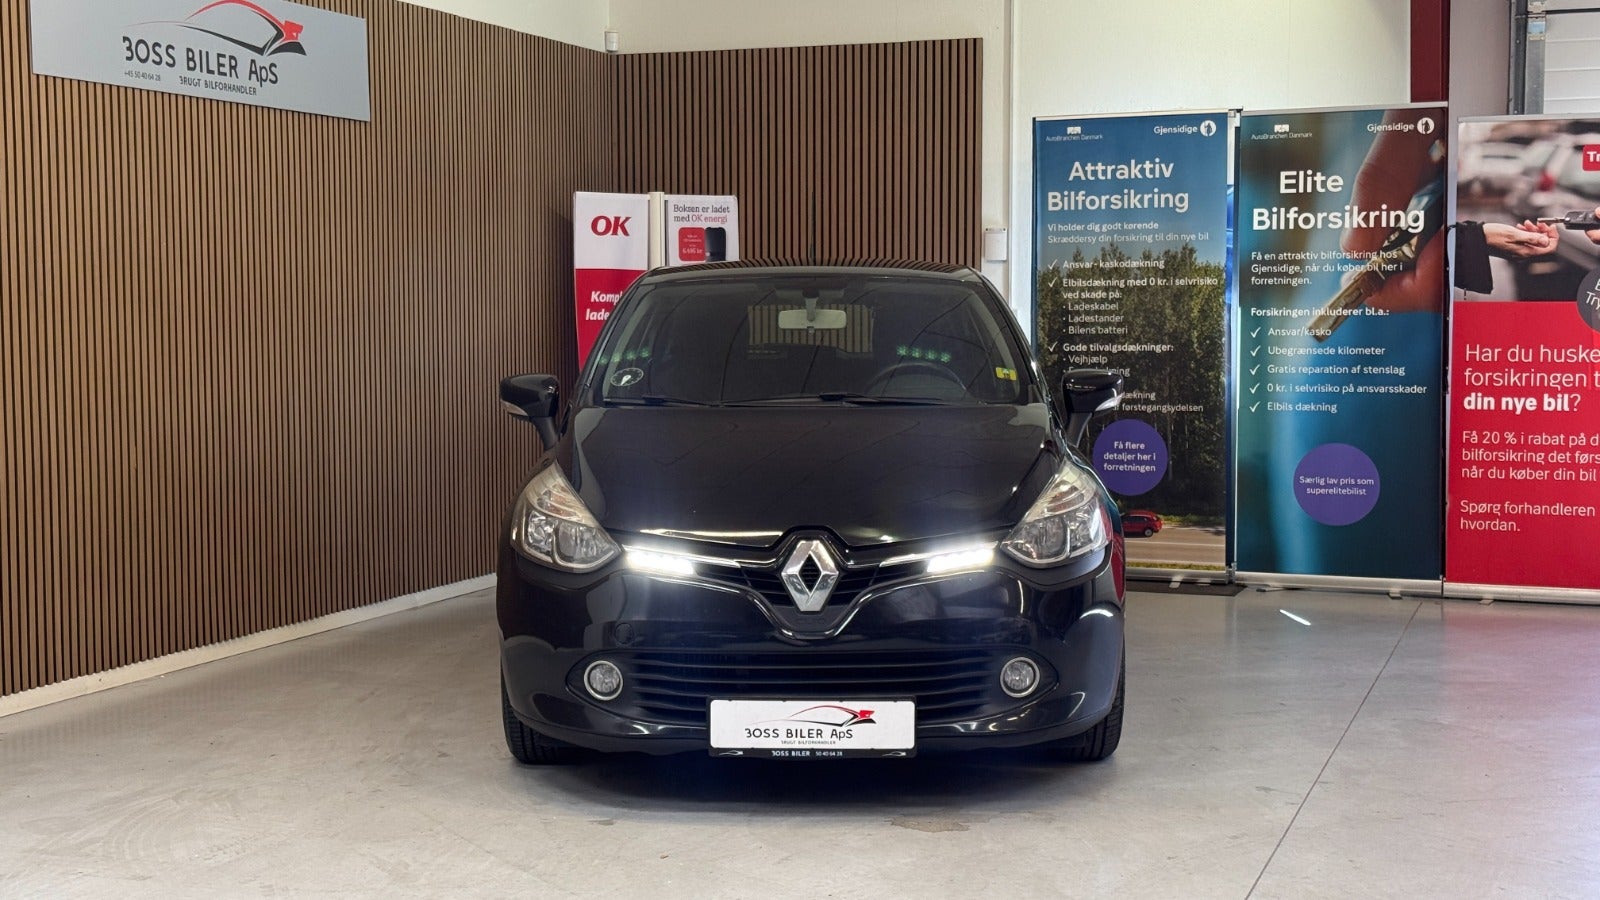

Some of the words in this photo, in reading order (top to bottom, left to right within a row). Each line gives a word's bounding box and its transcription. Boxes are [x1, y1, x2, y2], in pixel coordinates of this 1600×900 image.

[186, 47, 239, 79] BILER
[248, 58, 279, 87] ApS
[204, 79, 257, 96] BILFORHANDLER
[1153, 125, 1198, 136] Gjensidige
[1367, 122, 1415, 133] Gjensidige
[1068, 157, 1174, 181] Attraktiv
[1279, 169, 1344, 194] Elite
[1047, 187, 1190, 213] Bilforsikring
[673, 204, 700, 213] Boksen
[712, 204, 730, 214] ladet
[673, 214, 690, 222] med
[692, 214, 703, 222] OK
[704, 214, 728, 225] energi
[1252, 203, 1425, 234] Bilforsikring
[590, 215, 632, 237] OK
[1047, 223, 1057, 232] Vi
[1058, 222, 1085, 232] holder
[1086, 222, 1100, 232] dig
[1101, 222, 1122, 232] godt
[1123, 221, 1159, 230] kørende
[1047, 234, 1097, 245] Skræddersy
[1098, 234, 1112, 242] din
[1114, 233, 1153, 244] forsikring
[1155, 233, 1164, 241] til
[1165, 232, 1178, 241] din
[1180, 233, 1197, 243] nye
[1198, 232, 1209, 240] bil
[1251, 250, 1263, 261] Få
[1277, 250, 1319, 260] attraktiv
[1320, 250, 1377, 262] bilforsikring
[1379, 250, 1398, 260] hos
[1062, 260, 1098, 269] Ansvar-
[1099, 258, 1165, 270] kaskodækning
[1251, 263, 1303, 274] Gjensidige,
[1305, 262, 1321, 272] når
[1323, 263, 1335, 272] du
[1336, 262, 1364, 272] køber
[1367, 262, 1379, 272] bil
[1381, 262, 1398, 272] her
[1400, 262, 1403, 271] i
[1062, 278, 1126, 289] Elbilsdækning
[1127, 278, 1148, 286] med
[1149, 278, 1156, 286] 0
[1157, 278, 1169, 286] kr.
[1170, 278, 1174, 286] i
[1175, 276, 1218, 286] selvrisiko
[1251, 276, 1312, 287] forretningen.
[1062, 290, 1079, 299] ved
[1080, 290, 1107, 299] skade
[1108, 289, 1123, 300] på:
[1068, 302, 1119, 311] Ladeskabel
[1250, 307, 1310, 318] Forsikringen
[1312, 307, 1363, 316] inkluderer
[1365, 308, 1390, 316] bl.a.:
[1068, 314, 1124, 323] Ladestander
[1068, 326, 1096, 334] Bilens
[1097, 326, 1128, 334] batteri
[1267, 326, 1332, 337] Ansvar/kasko
[1062, 343, 1088, 352] Gode
[1090, 343, 1174, 353] tilvalgsdækninger:
[1267, 346, 1336, 357] Ubegrænsede
[1337, 346, 1386, 356] kilometer
[1465, 344, 1502, 362] Har
[1507, 344, 1533, 363] du
[1068, 355, 1108, 364] Vejhjælp
[1267, 364, 1296, 374] Gratis
[1298, 364, 1349, 376] reparation
[1351, 364, 1361, 374] af
[1363, 364, 1406, 376] stenslag
[1464, 368, 1587, 392] forsikringen
[1267, 383, 1274, 392] 0
[1276, 383, 1288, 392] kr.
[1294, 383, 1340, 393] selvrisiko
[1342, 382, 1355, 395] på
[1356, 384, 1427, 394] ansvarsskader
[1122, 403, 1204, 413] førstegangsydelsen
[1267, 402, 1294, 412] Elbils
[1295, 402, 1338, 414] dækning
[1463, 392, 1496, 410] din
[1500, 396, 1538, 415] nye
[1543, 393, 1581, 412] bil?
[1114, 440, 1124, 450] Få
[1125, 441, 1146, 450] flere
[1462, 430, 1478, 444] Få
[1482, 431, 1500, 444] 20
[1504, 431, 1517, 445] %
[1520, 432, 1524, 444] i
[1528, 432, 1565, 446] rabat
[1568, 432, 1586, 448] på
[1103, 452, 1136, 462] detaljer
[1137, 452, 1152, 461] her
[1462, 448, 1545, 465] bilforsikring
[1548, 450, 1572, 464] det
[1103, 463, 1156, 474] forretningen
[1462, 465, 1484, 478] når
[1487, 466, 1505, 479] du
[1509, 466, 1550, 480] køber
[1553, 467, 1576, 481] din
[1580, 468, 1597, 482] bil
[1299, 476, 1326, 486] Særlig
[1326, 476, 1338, 484] lav
[1340, 476, 1356, 486] pris
[1306, 487, 1367, 496] superelitebilist
[1460, 500, 1502, 516] Spørg
[1504, 501, 1596, 517] forhandleren
[1460, 516, 1520, 532] hvordan.
[786, 728, 823, 738] BILER
[830, 728, 853, 741] ApS
